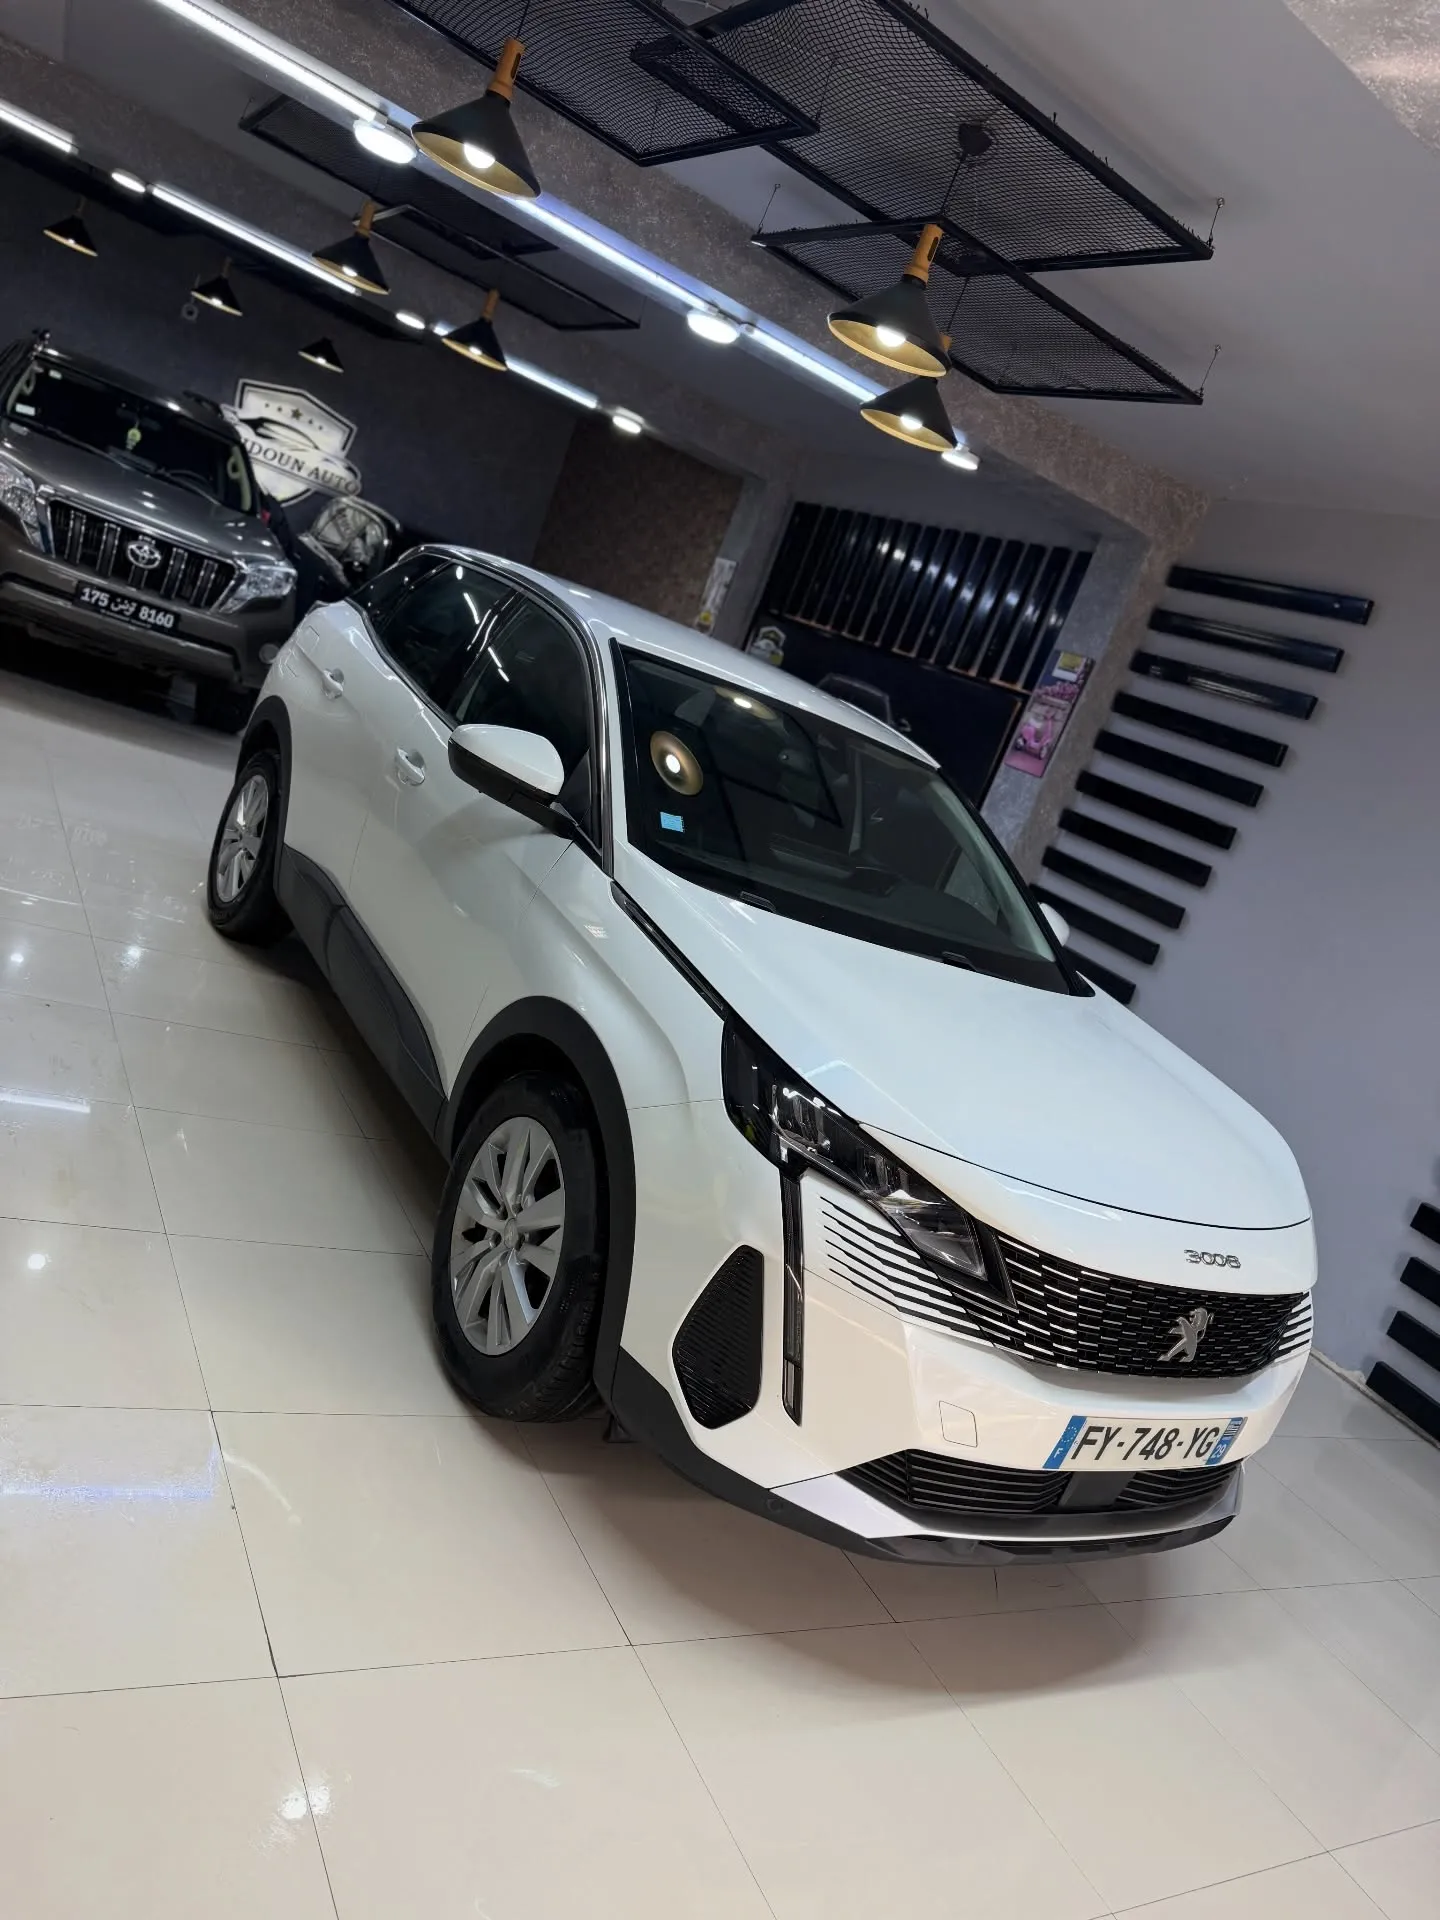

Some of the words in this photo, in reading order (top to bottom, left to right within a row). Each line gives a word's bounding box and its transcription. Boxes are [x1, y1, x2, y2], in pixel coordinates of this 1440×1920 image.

[307, 467, 359, 495] AUTO
[80, 587, 110, 607] 175
[139, 606, 174, 629] 8160
[1183, 1249, 1241, 1269] 3008
[1053, 1447, 1064, 1459] F
[1070, 1425, 1220, 1460] FY-748-YG
[1210, 1443, 1227, 1459] 29
